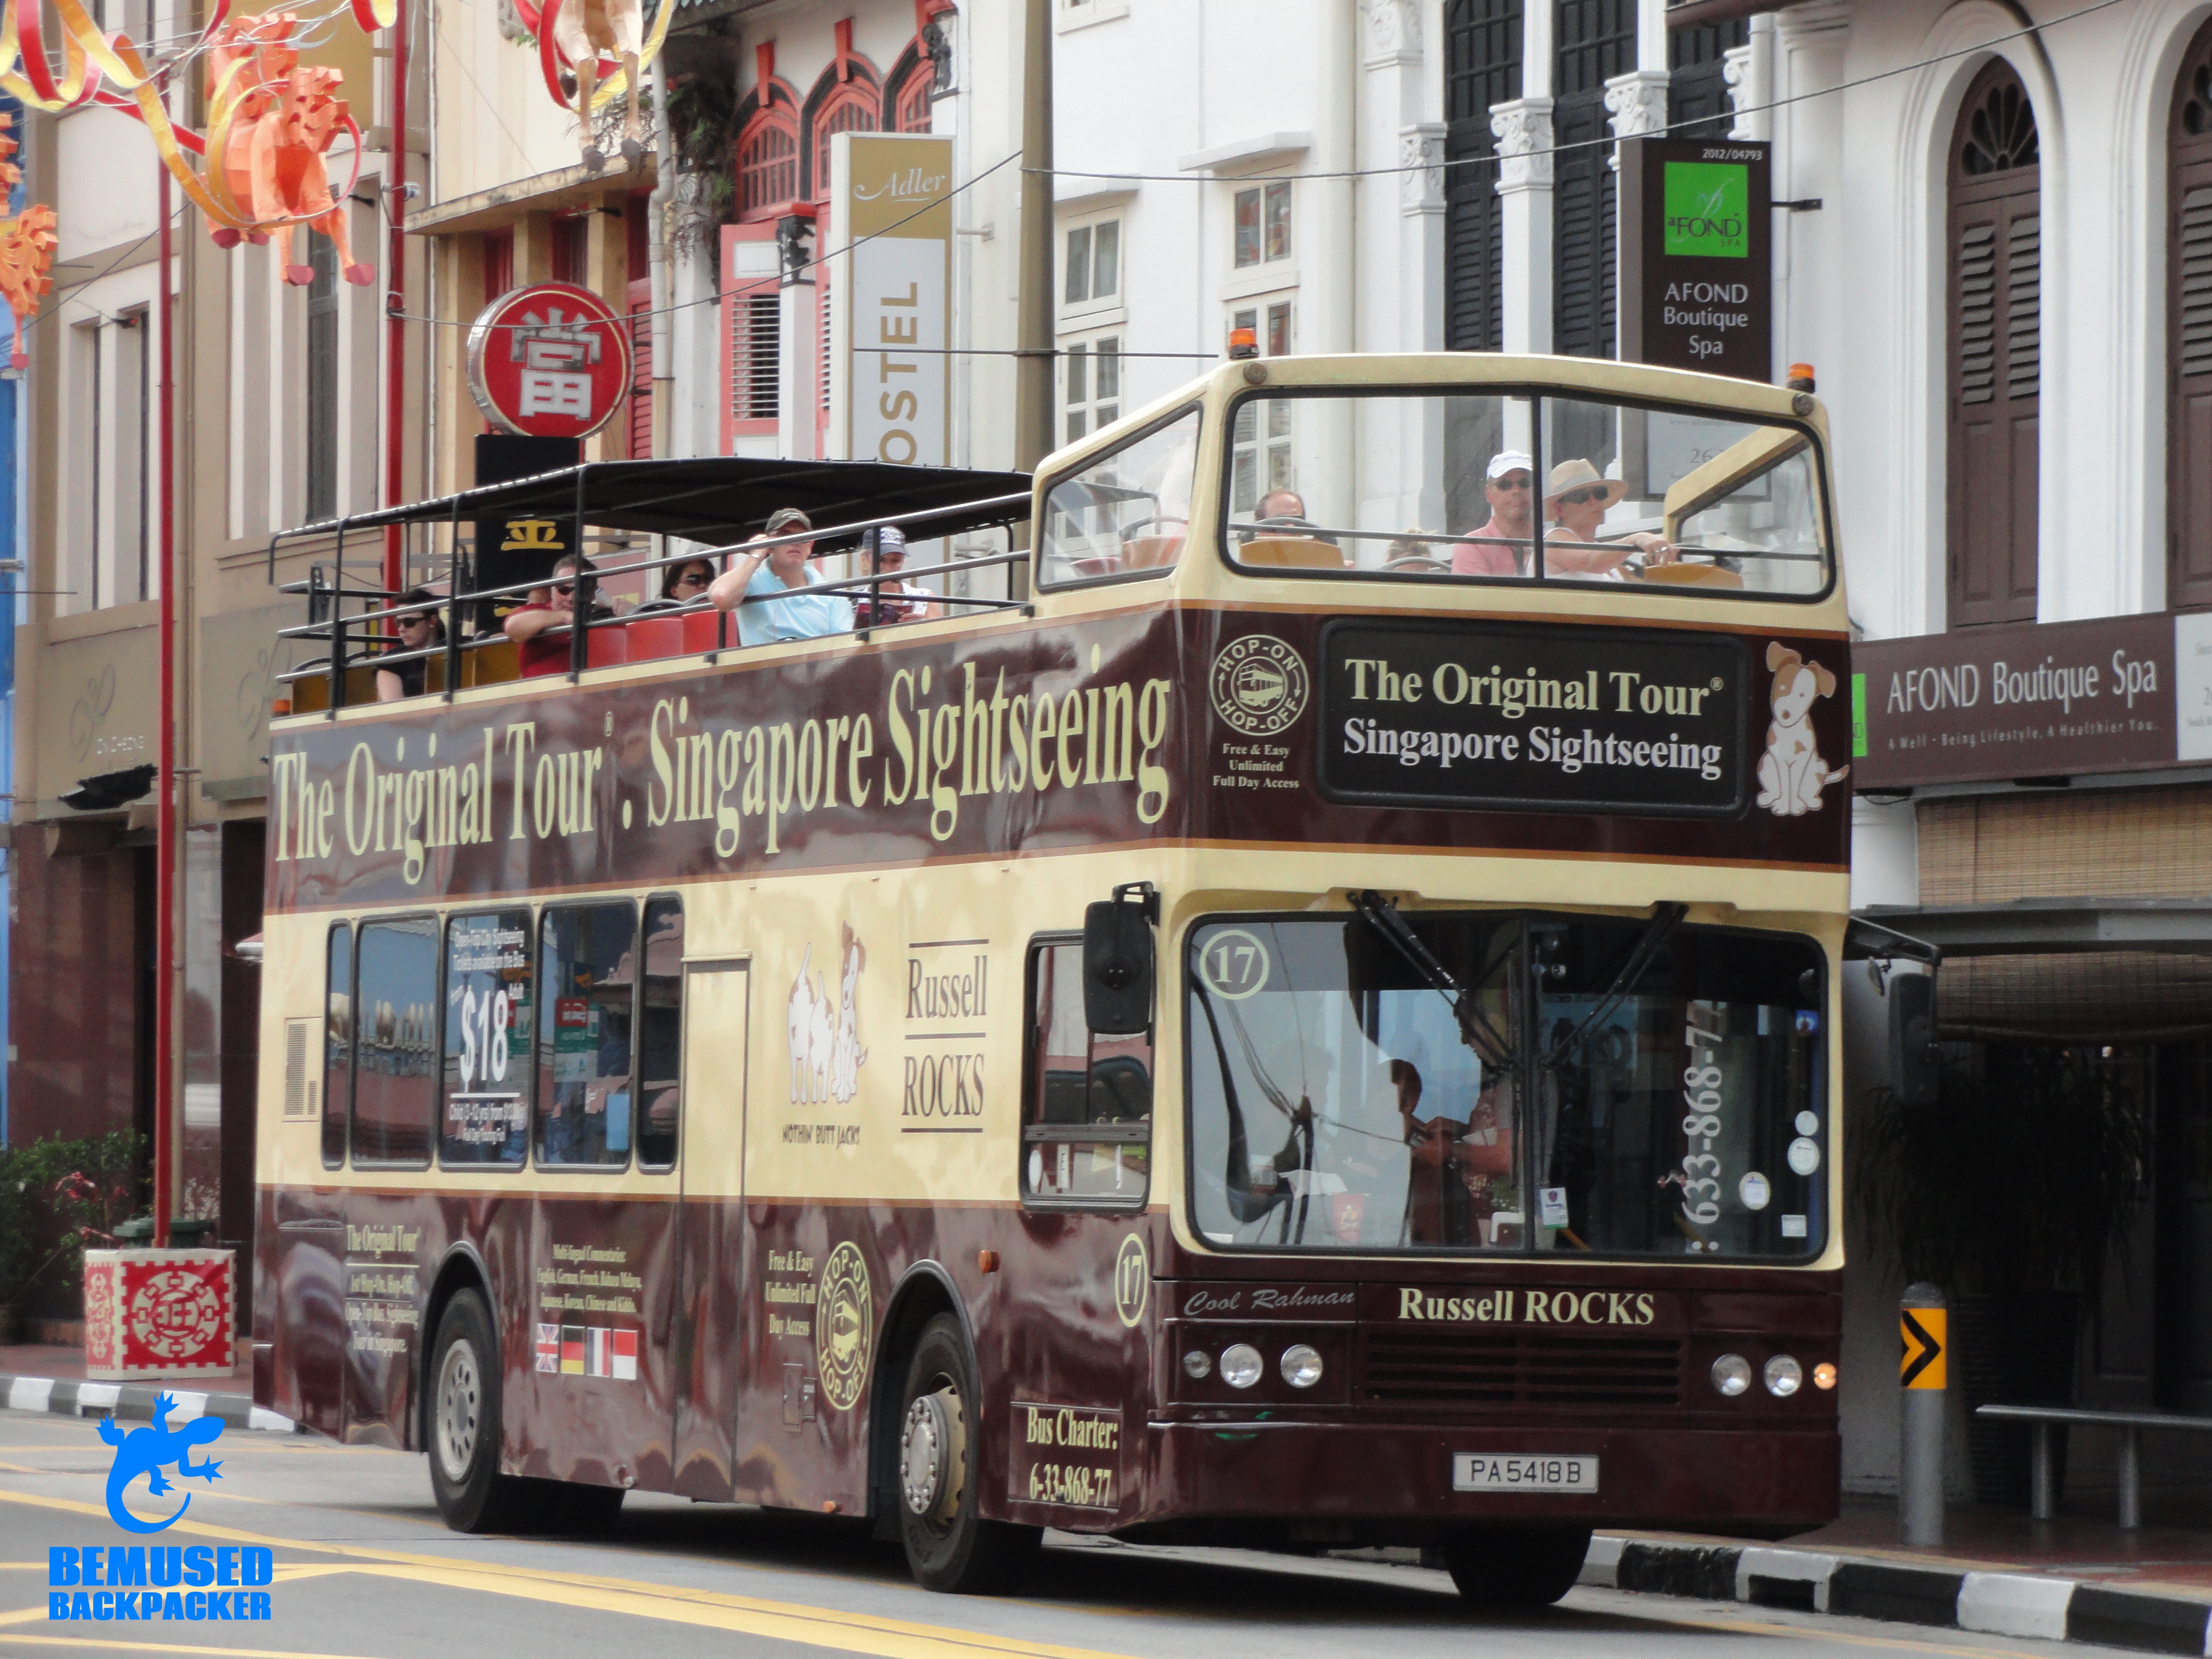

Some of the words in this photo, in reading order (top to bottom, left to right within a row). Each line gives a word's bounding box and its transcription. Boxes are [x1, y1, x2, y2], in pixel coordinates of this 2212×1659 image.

[854, 168, 947, 201] Adler
[1664, 283, 1748, 304] AFOND
[1664, 308, 1748, 332] Boutique
[1689, 336, 1724, 359] Spa
[1219, 640, 1299, 671] HOP-ON
[1345, 658, 1422, 702] The
[1433, 663, 1599, 718] Original
[1887, 665, 1980, 713] AFOND
[1993, 656, 2098, 714] Boutique
[2112, 649, 2157, 709] Spa
[1220, 697, 1298, 730] HOP-OFF
[273, 752, 334, 862] The
[345, 727, 493, 885] Original
[648, 696, 874, 858] Singapore
[884, 644, 1170, 841] Sightseeing
[1223, 743, 1247, 754] Free
[1251, 744, 1260, 755] &
[1264, 745, 1290, 758] Easy
[1229, 760, 1284, 771] Unlimited
[1344, 717, 1520, 768] Singapore
[1528, 726, 1722, 780] Sightseeing
[1213, 776, 1235, 786] Full
[1238, 776, 1260, 790] Day
[1263, 777, 1299, 788] Access
[1214, 946, 1256, 983] 17
[906, 955, 988, 1019] Russell
[460, 985, 508, 1093] $18
[902, 1053, 985, 1117] ROCKS
[769, 1250, 785, 1271] Free
[786, 1251, 794, 1271] &
[796, 1250, 815, 1277] Easy
[823, 1250, 867, 1303] HOP-ON
[1121, 1254, 1142, 1305] 17
[1184, 1291, 1241, 1315] Cool
[1251, 1286, 1355, 1309] Rahman
[1398, 1288, 1512, 1322] Russell
[1523, 1290, 1654, 1325] ROCKS
[770, 1314, 785, 1339] Day
[786, 1316, 810, 1336] Access
[820, 1348, 864, 1401] HOP-OFF
[1027, 1407, 1053, 1445] Bus
[1056, 1409, 1118, 1449] Charter:
[1029, 1463, 1112, 1506] 6-33-868-77
[1470, 1460, 1581, 1483] PA5418B
